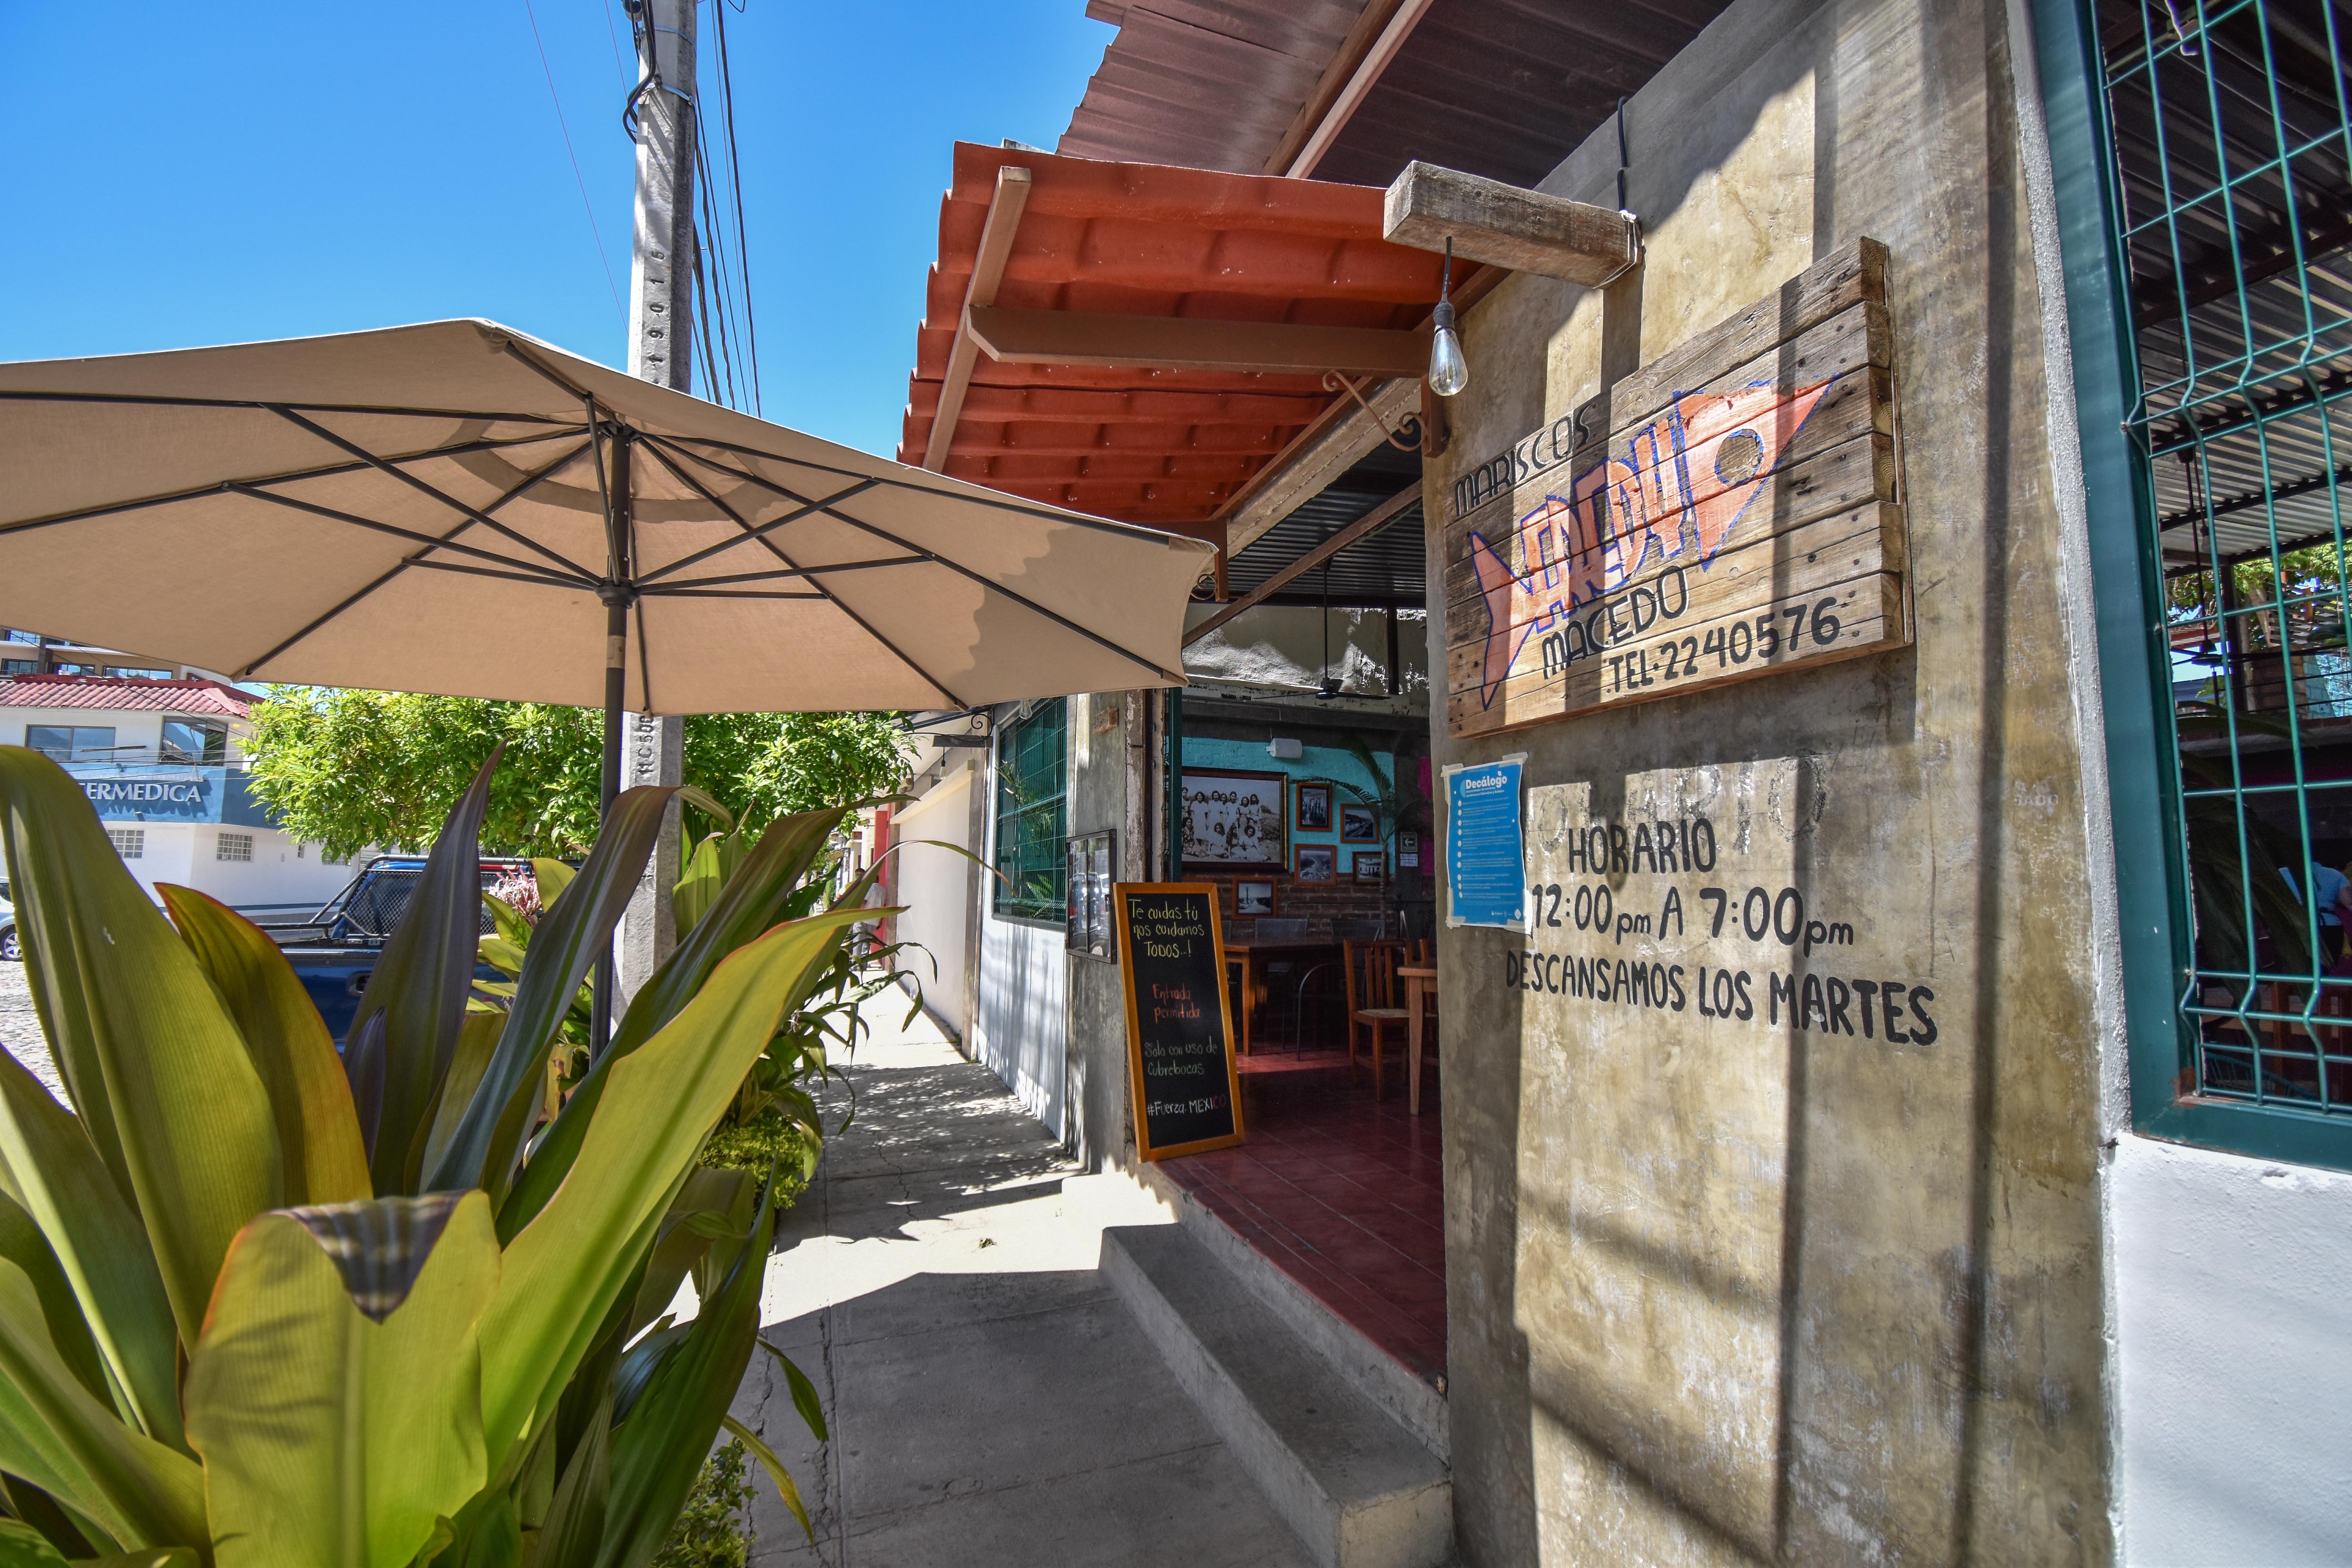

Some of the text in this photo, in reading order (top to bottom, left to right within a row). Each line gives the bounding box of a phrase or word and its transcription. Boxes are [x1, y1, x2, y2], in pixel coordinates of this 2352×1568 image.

[1455, 404, 1590, 517] MARISCOS
[1542, 565, 1689, 680] MACEDO
[1466, 775, 1507, 789] Decálogo
[1568, 818, 1717, 875] HORARIO
[1127, 899, 1144, 919] Te
[1148, 901, 1181, 919] cuidas
[1659, 886, 1684, 941] A
[1133, 922, 1204, 940] nos cuidamos
[1153, 982, 1191, 1006] Entrada
[1506, 950, 1938, 1046] DESCANSAMOS LOS MARTES
[1154, 1002, 1200, 1025] permitida
[1169, 1045, 1183, 1055] con
[1185, 1043, 1203, 1054] uso
[1206, 1035, 1217, 1054] de
